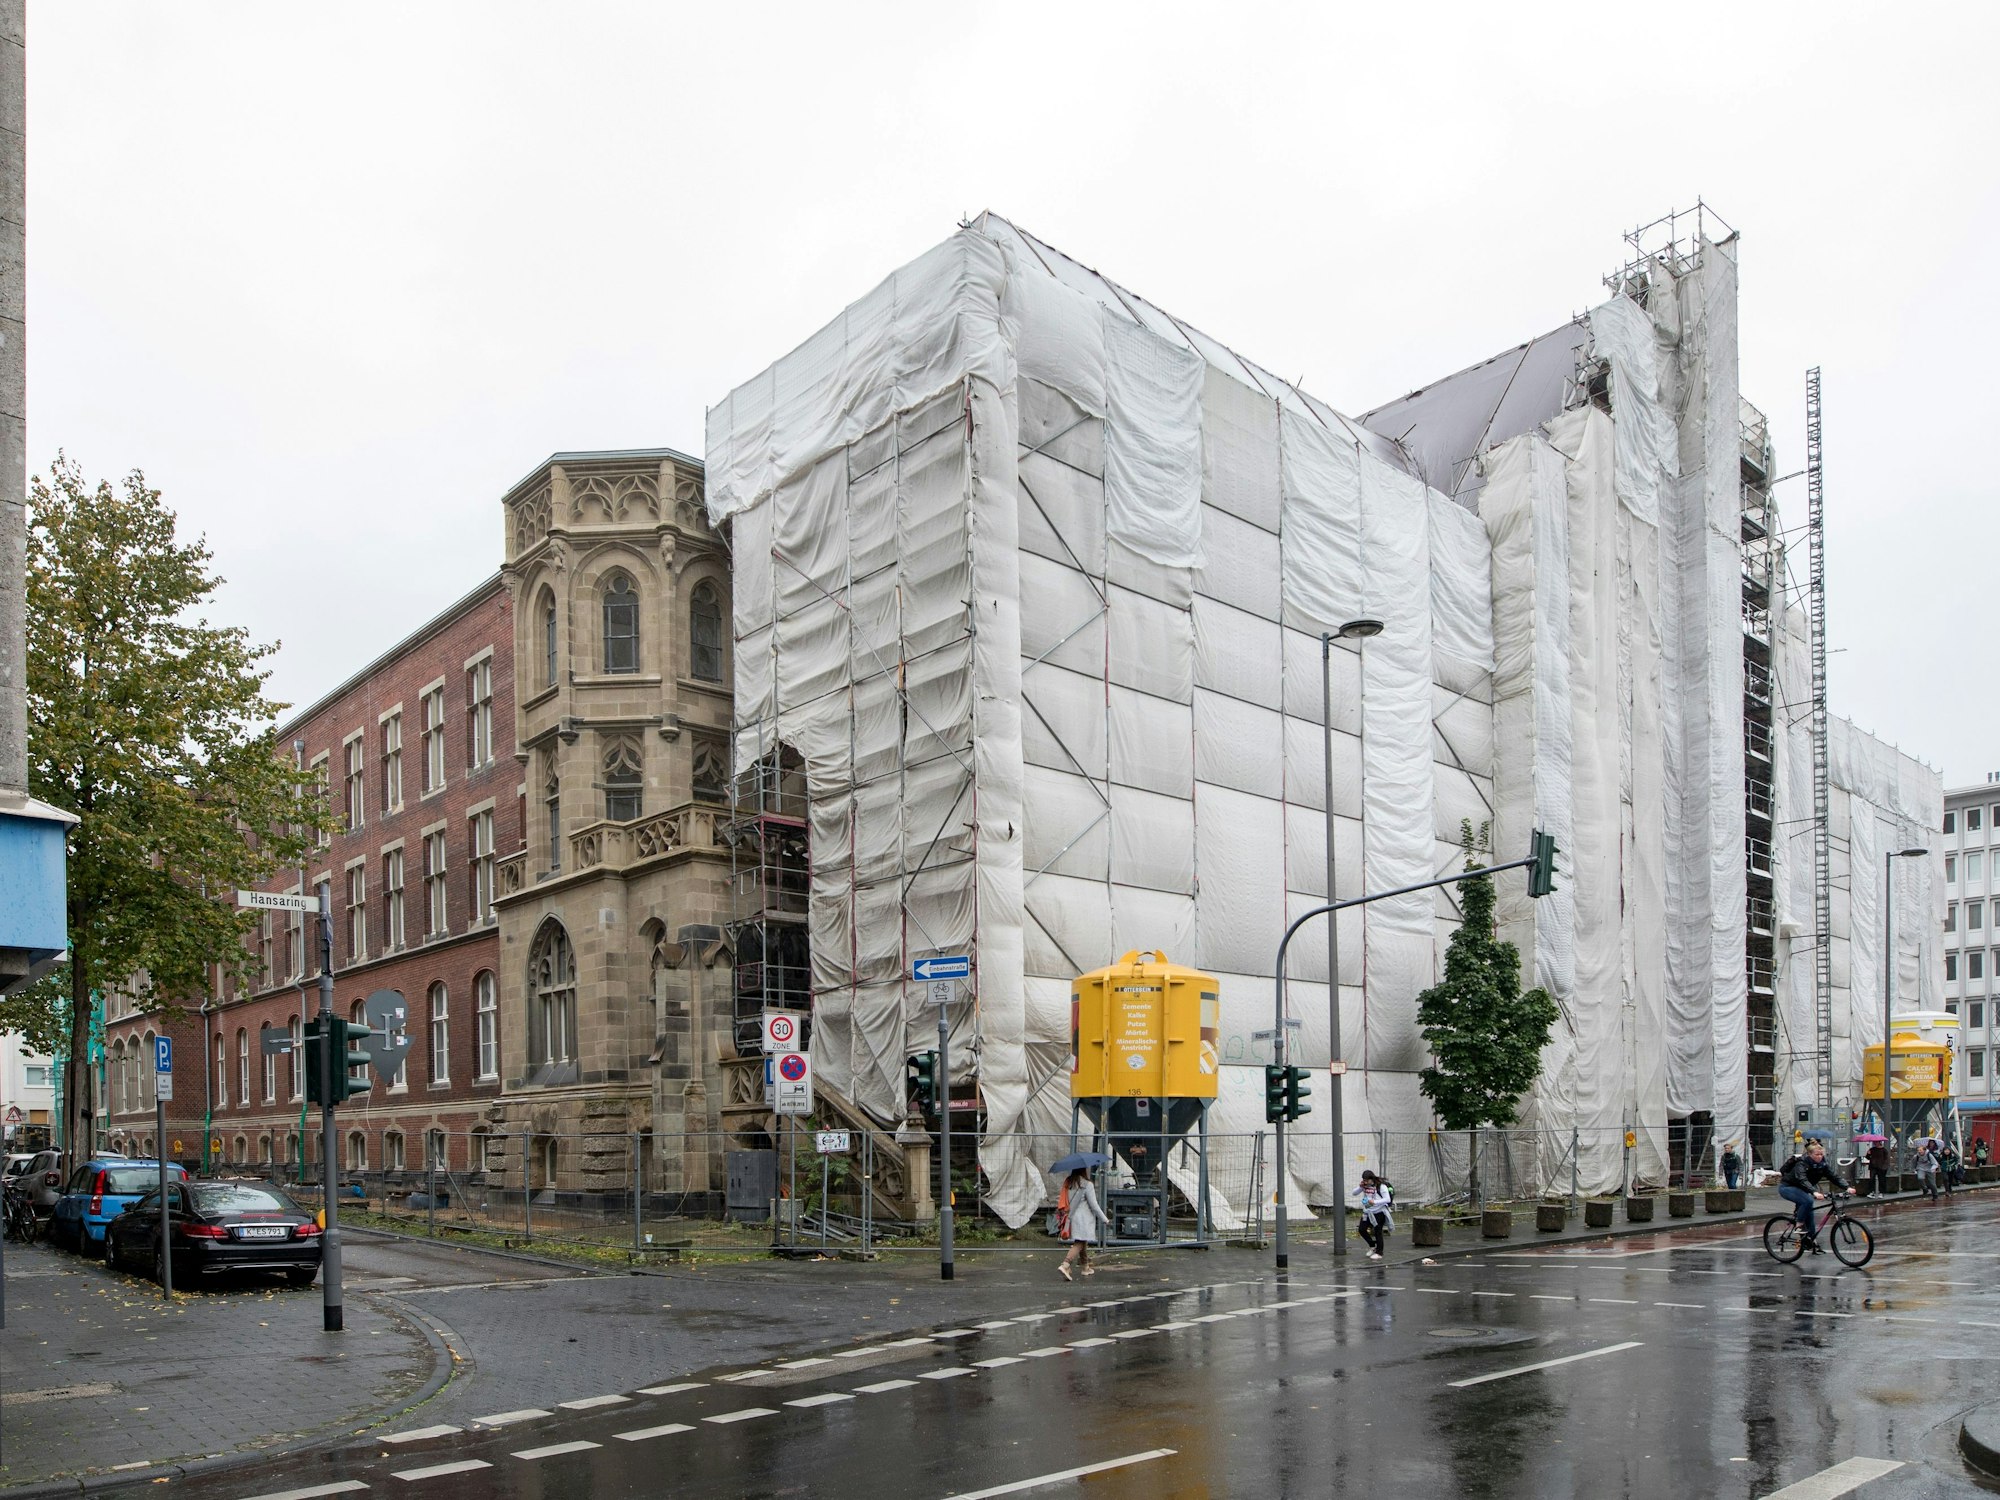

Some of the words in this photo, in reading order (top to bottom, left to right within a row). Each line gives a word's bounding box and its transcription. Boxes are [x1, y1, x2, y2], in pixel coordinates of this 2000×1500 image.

[250, 892, 307, 910] Hansaring
[774, 1023, 789, 1035] 30
[158, 1041, 168, 1068] P
[1128, 1088, 1142, 1096] 136
